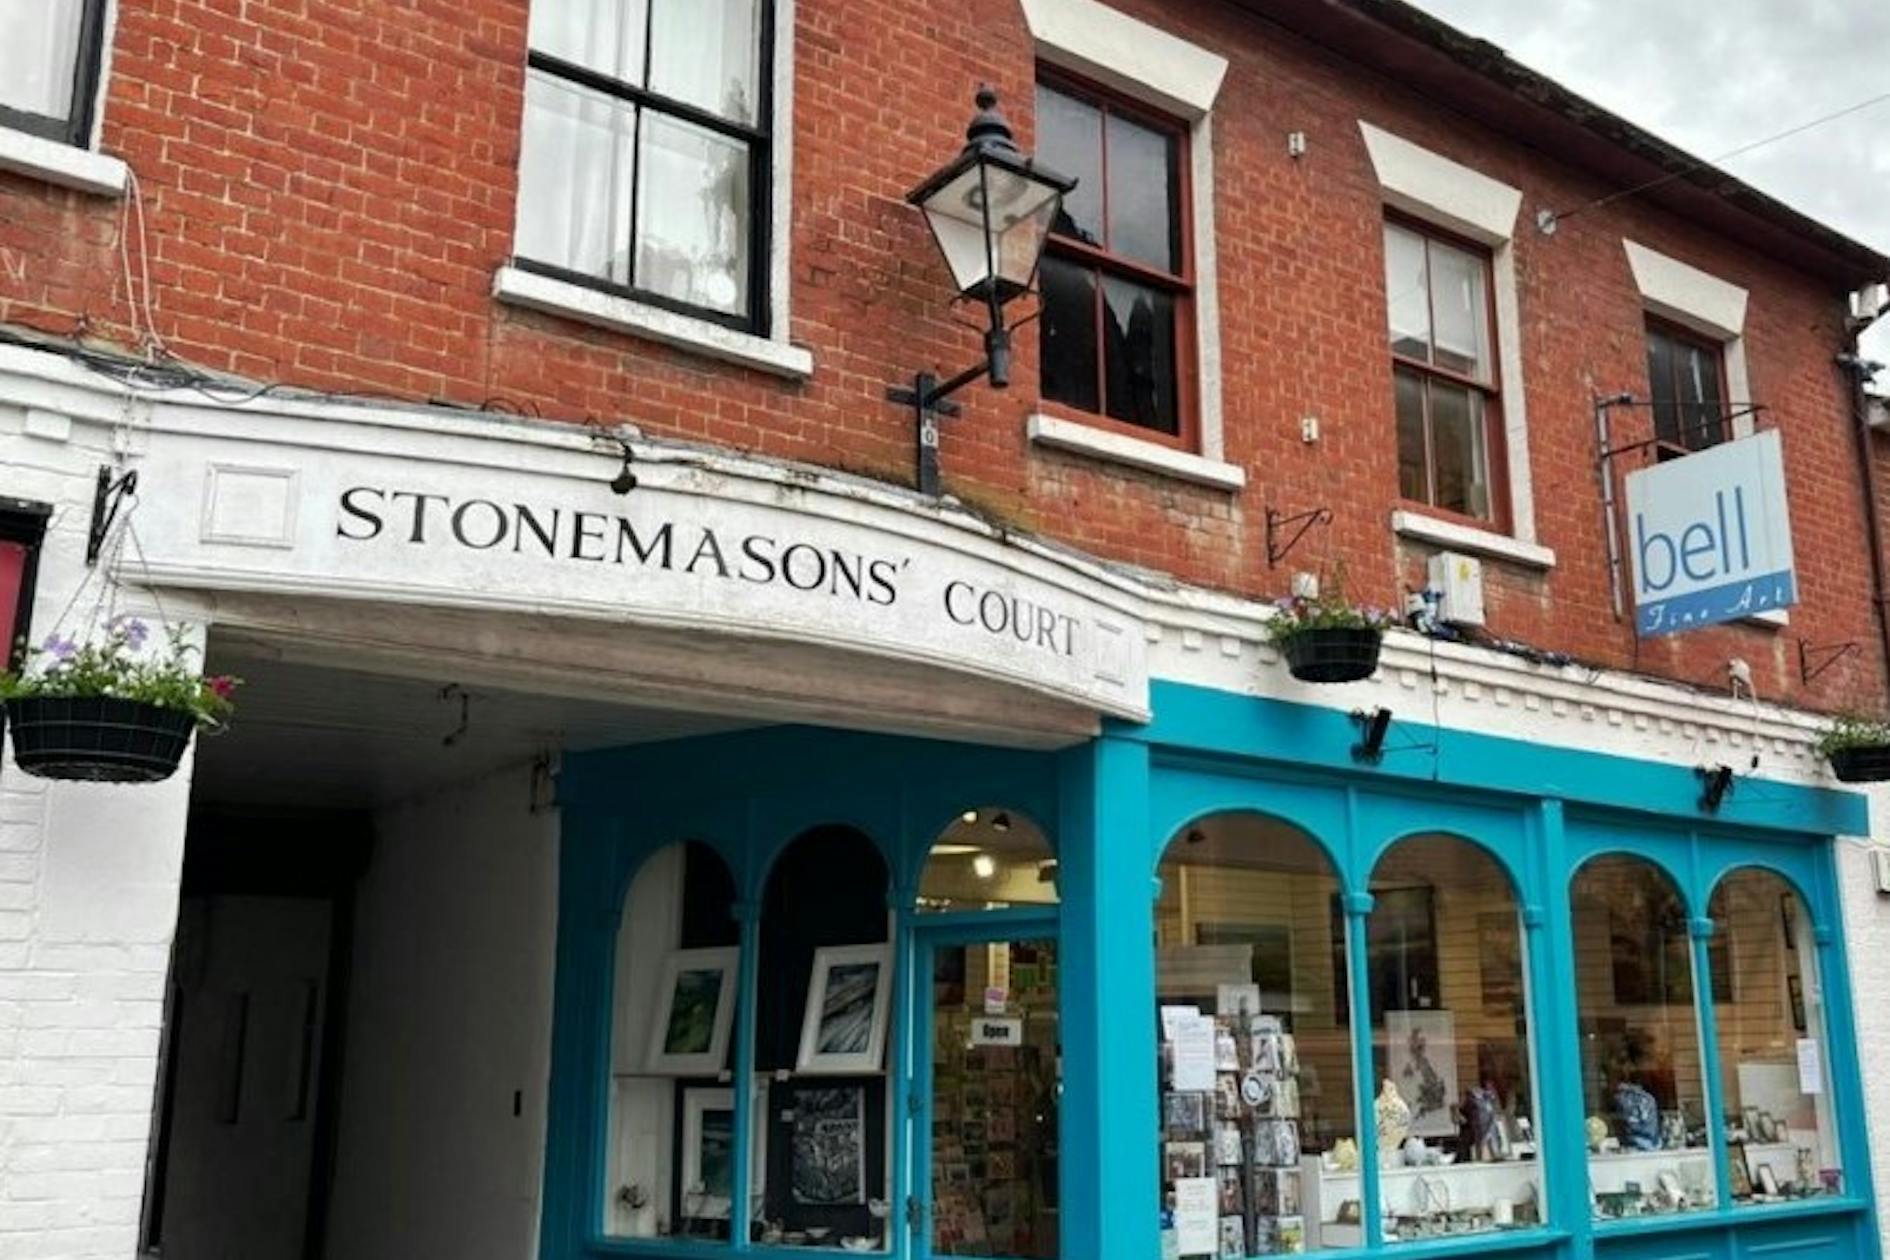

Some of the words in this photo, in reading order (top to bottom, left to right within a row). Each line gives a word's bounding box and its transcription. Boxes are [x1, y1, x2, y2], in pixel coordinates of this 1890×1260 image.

[336, 486, 909, 606] STONEMASONS'
[944, 580, 1080, 656] COURT
[1637, 486, 1749, 594] bell
[983, 1023, 1009, 1038] Open
